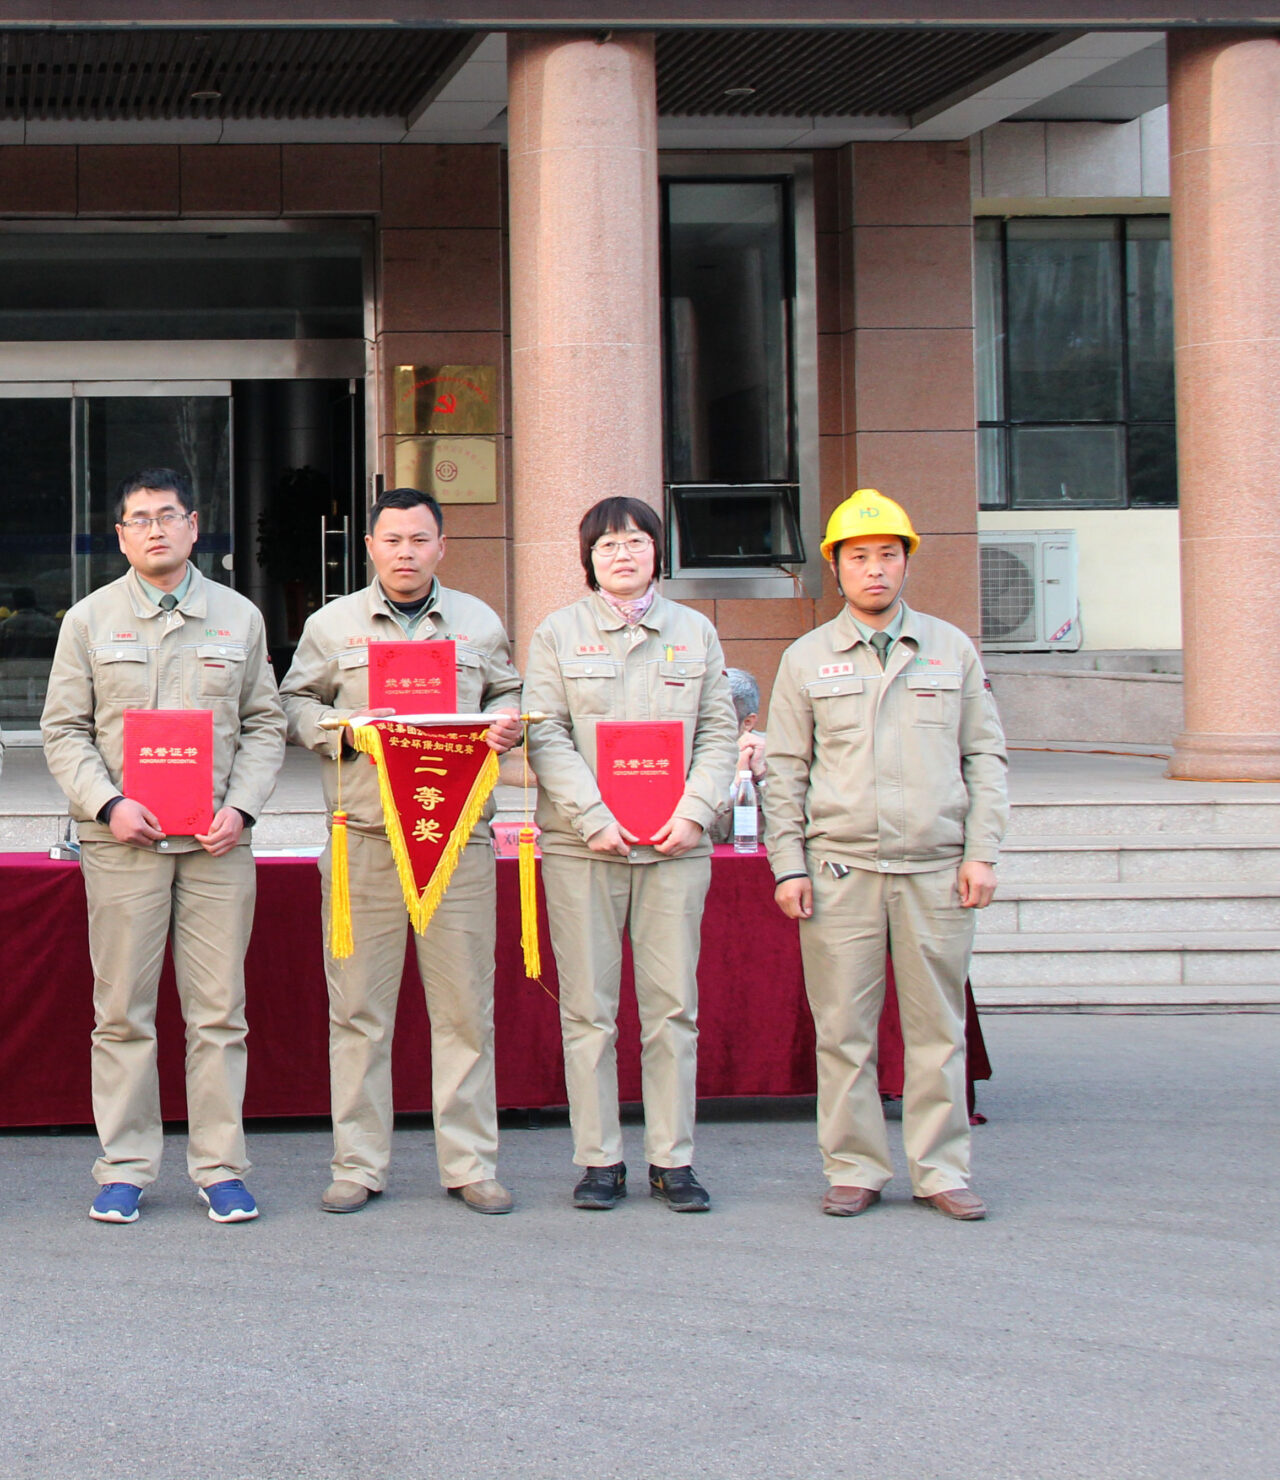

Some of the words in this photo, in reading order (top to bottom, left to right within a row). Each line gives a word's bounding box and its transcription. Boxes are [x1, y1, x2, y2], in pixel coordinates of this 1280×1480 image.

[384, 677, 441, 688] 荣誉证书
[389, 736, 474, 755] 安全环保知识竞赛
[139, 746, 198, 757] 荣誉证书
[612, 758, 670, 769] 荣誉证书
[412, 755, 448, 844] 二等奖
